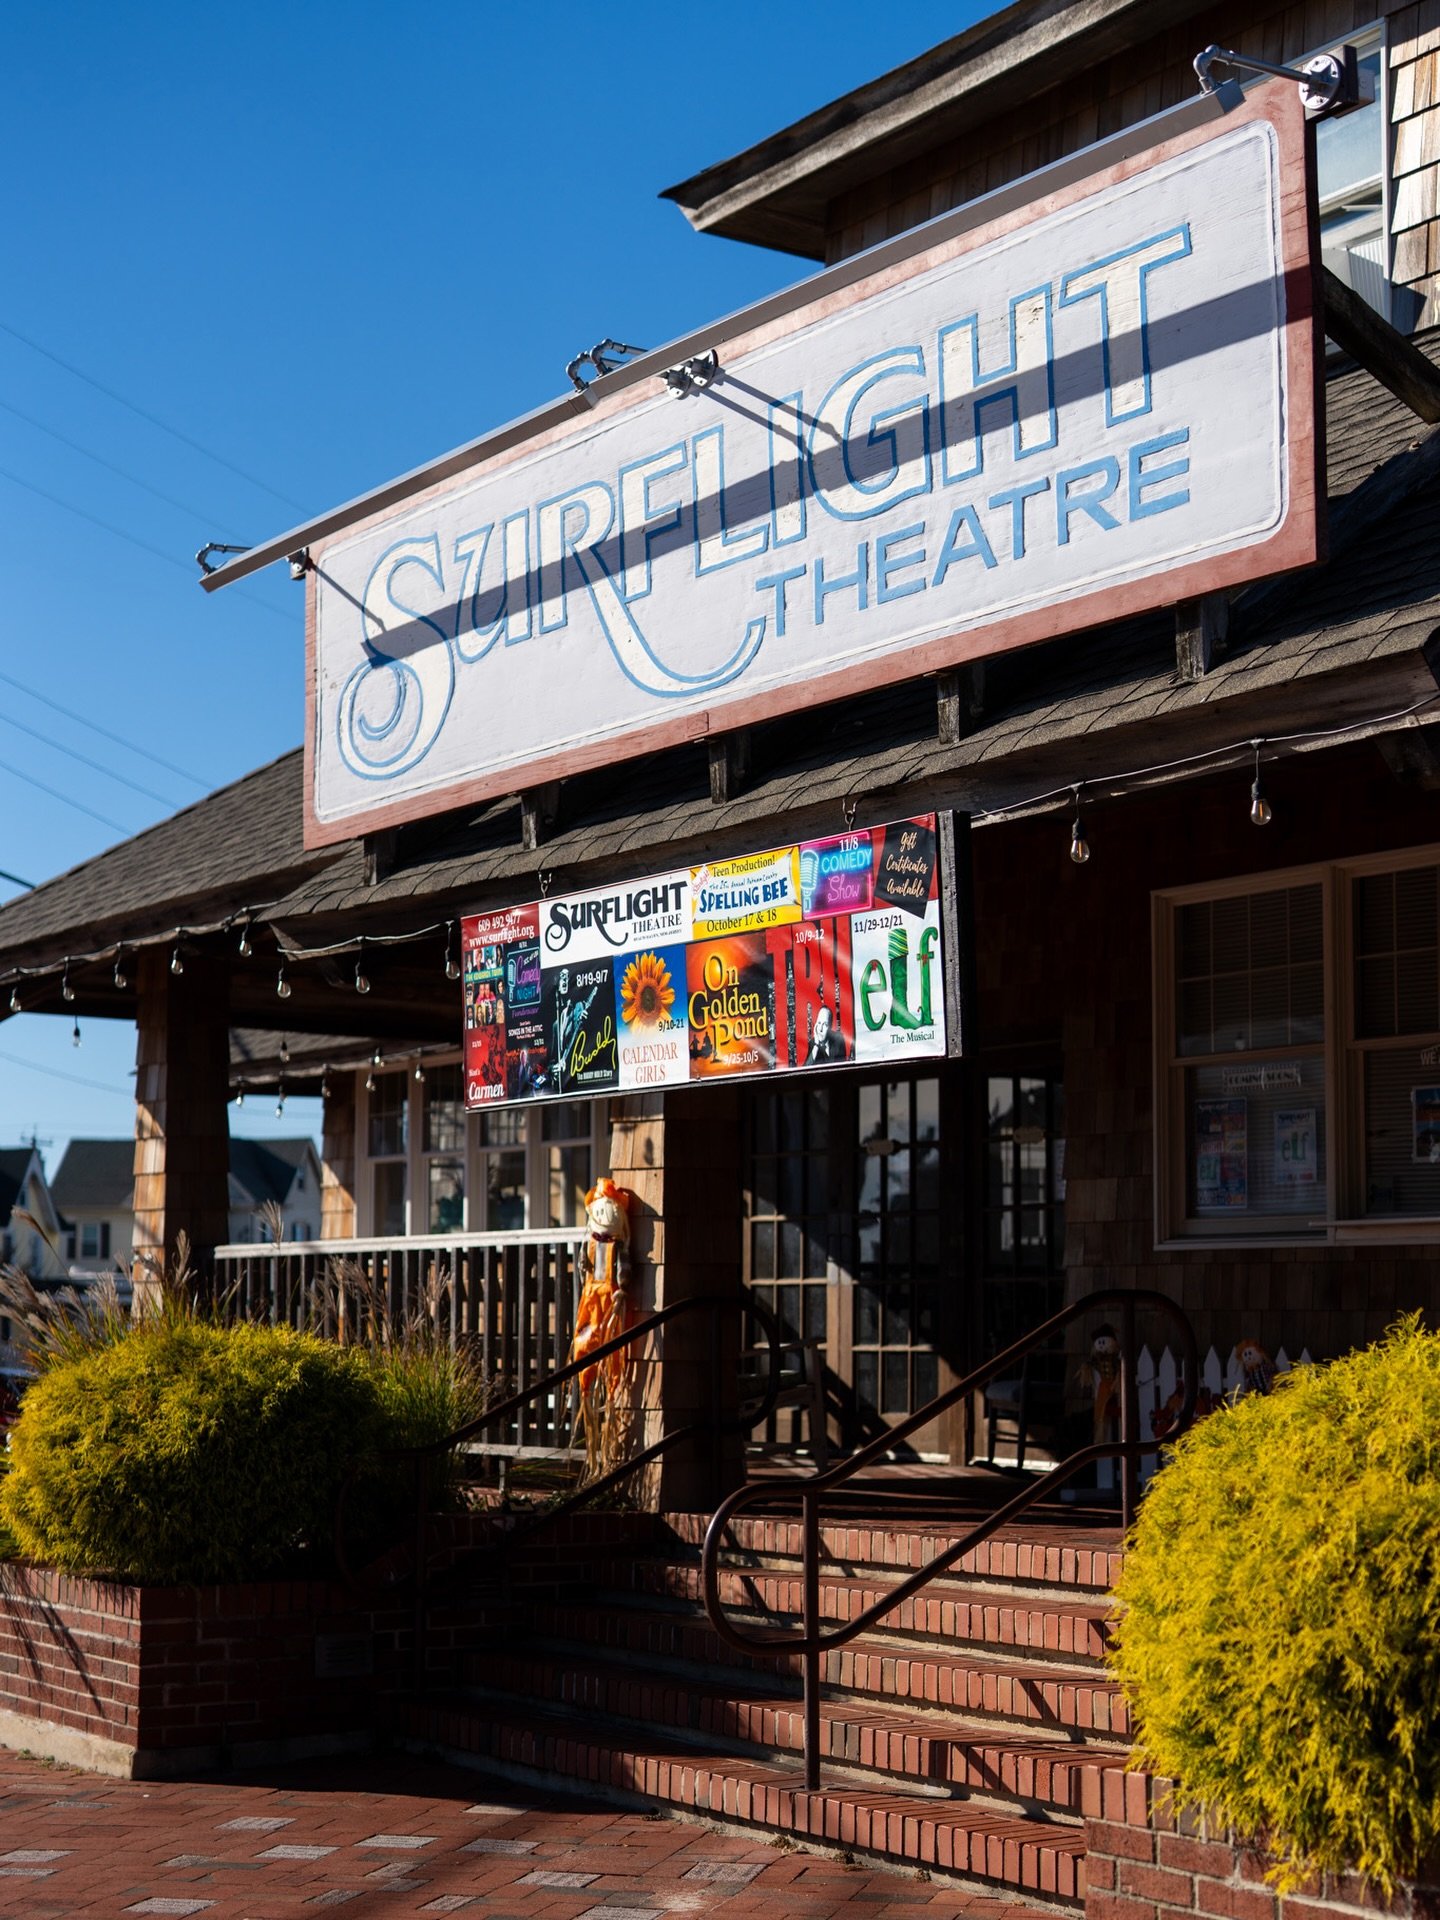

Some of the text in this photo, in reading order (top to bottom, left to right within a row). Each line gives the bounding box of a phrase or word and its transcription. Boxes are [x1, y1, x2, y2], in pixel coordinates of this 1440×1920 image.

[335, 223, 1191, 780] SURFLIGHT
[755, 426, 1190, 637] THEATRE
[839, 836, 859, 853] 11/8
[900, 831, 917, 852] Gift
[712, 855, 775, 878] Teen Production!
[821, 848, 872, 875] COMEDY
[886, 855, 929, 875] Certificates
[699, 877, 788, 913] SPELLING BEE
[827, 874, 860, 902] Show
[886, 879, 925, 897] Available
[478, 918, 491, 932] 609
[492, 915, 504, 929] 492
[545, 881, 688, 952] SURFLIGHT
[631, 912, 683, 934] THEATRE
[706, 909, 777, 933] October 17 & 18
[854, 915, 903, 933] 11/29-12/21
[469, 925, 535, 948] www.surflight.org
[795, 928, 825, 944] 10/9-12
[576, 969, 609, 988] 8/19-9/7
[704, 955, 740, 992] On
[688, 990, 760, 1030] Golden
[658, 1018, 685, 1033] 9/10-21
[712, 1006, 769, 1062] Pond
[570, 1015, 617, 1077] Buddy
[890, 1030, 935, 1044] The Musical
[622, 1042, 679, 1065] CALENDAR
[723, 1051, 759, 1066] 9/25-10/5
[635, 1064, 666, 1084] GIRLS
[468, 1081, 505, 1101] Carmen
